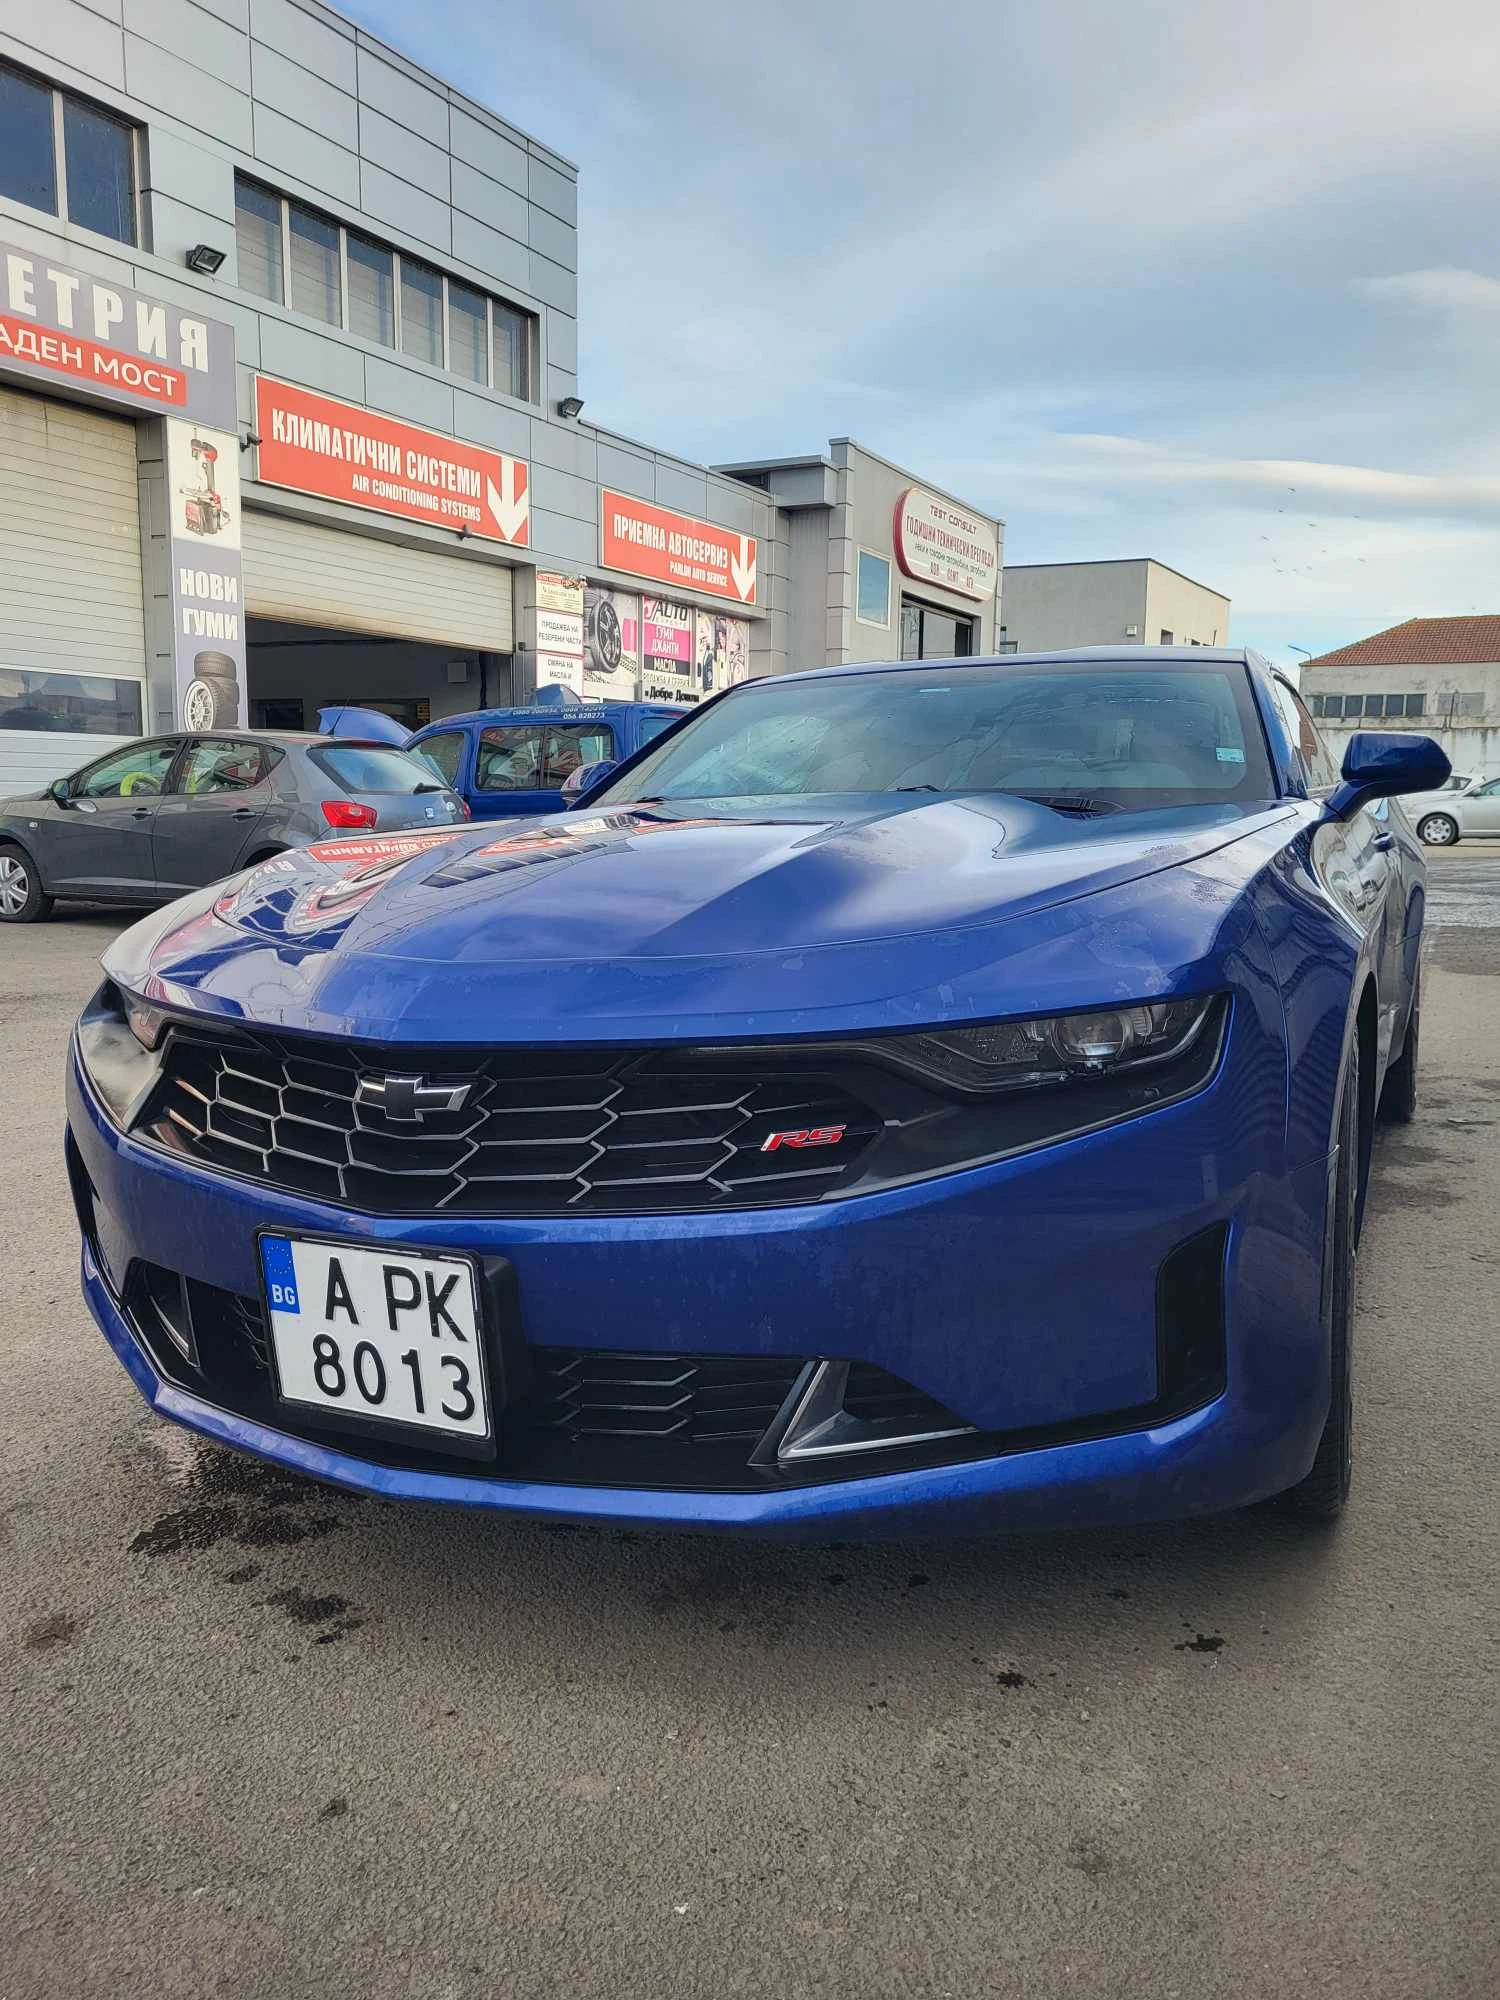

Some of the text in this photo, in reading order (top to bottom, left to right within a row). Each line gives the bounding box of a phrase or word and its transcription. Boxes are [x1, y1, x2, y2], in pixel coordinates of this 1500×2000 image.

[7, 254, 209, 373] ЕТРИЯ
[93, 352, 177, 396] МОСТ
[272, 408, 481, 498] КЛИМАТИЧНИ СИСТЕМИ
[352, 474, 481, 522] AIR CONDITIONING SYSTEMS
[930, 504, 977, 535] TEST CONSULT
[613, 513, 728, 569] ПРИЕМНА АВТОСЕРВИЗ
[179, 567, 238, 603] НОВИ
[692, 567, 706, 582] AUTO
[182, 607, 238, 641] ГУМИ
[541, 620, 570, 632] ПРОДАЖБА
[653, 600, 688, 622] AUTO
[651, 638, 680, 655] ДЖАНТИ
[655, 626, 675, 640] ГУМИ
[653, 657, 677, 673] МАСЛА
[650, 686, 673, 701] Добре
[761, 1125, 847, 1151] RS
[271, 1284, 296, 1305] BG
[325, 1256, 469, 1343] A PK
[313, 1333, 476, 1421] 8013
